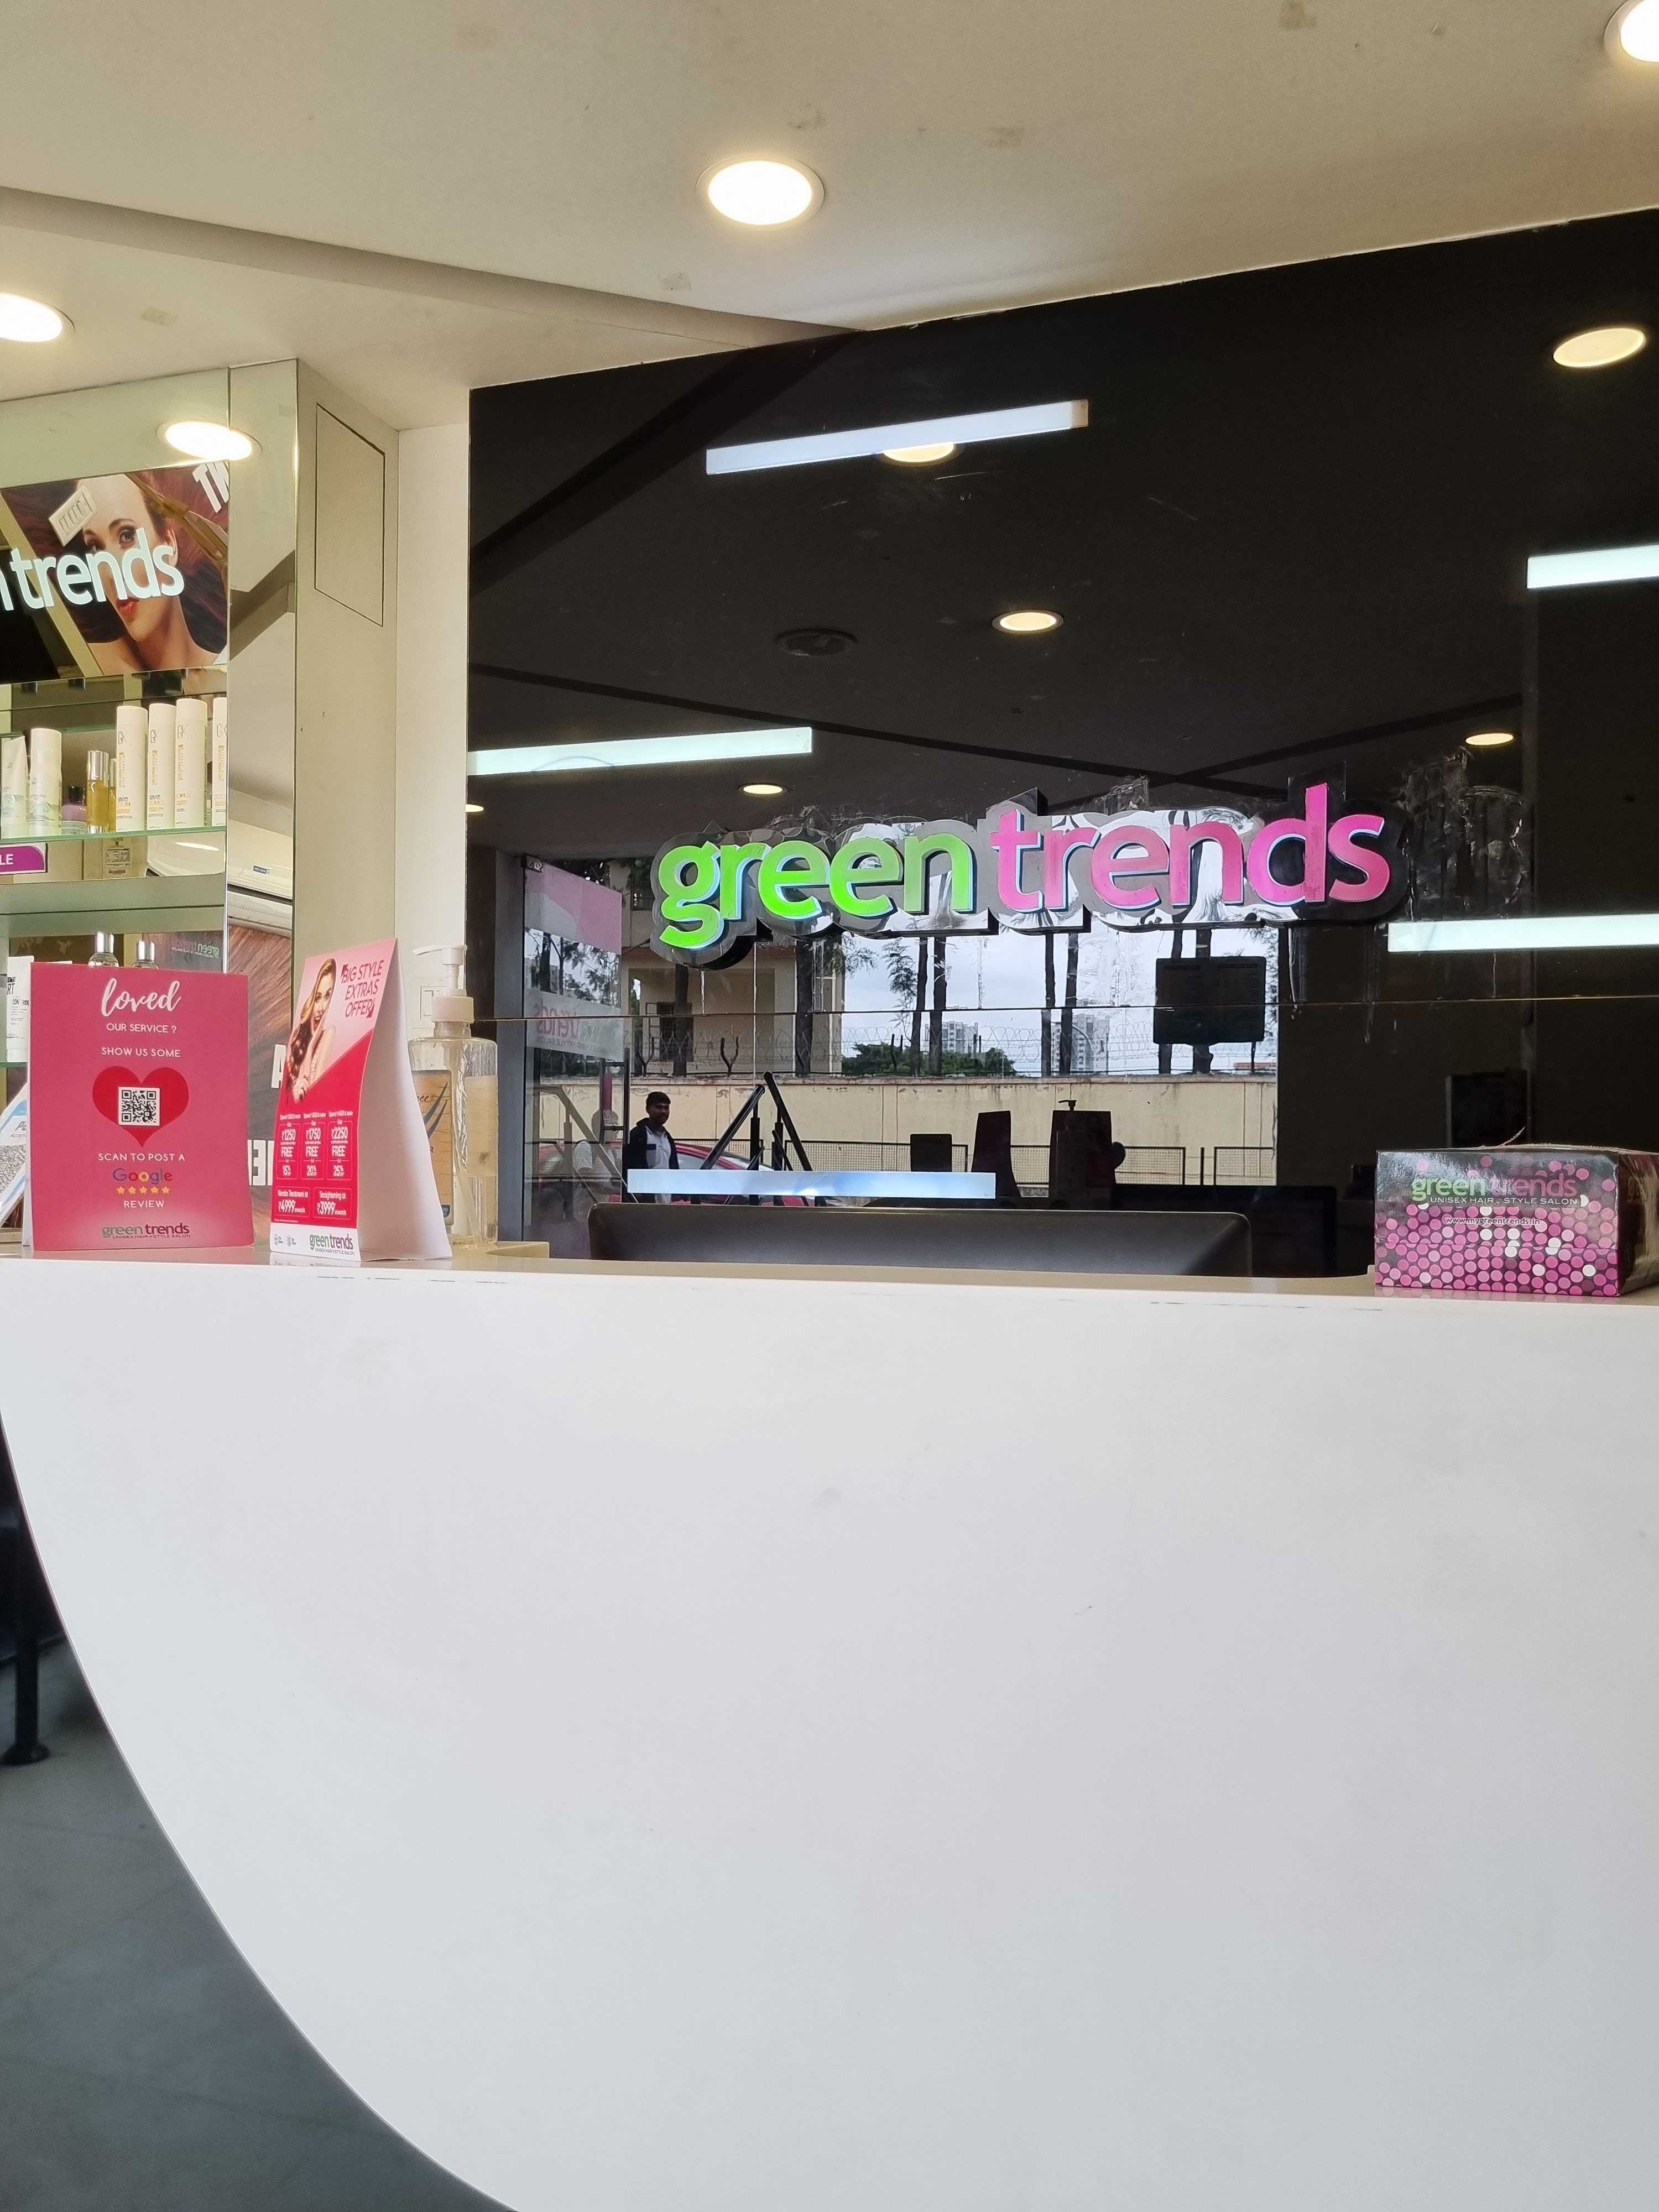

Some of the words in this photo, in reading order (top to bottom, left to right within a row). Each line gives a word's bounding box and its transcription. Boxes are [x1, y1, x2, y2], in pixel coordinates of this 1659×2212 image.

[10, 527, 184, 609] trends
[659, 833, 975, 949] green
[991, 783, 1391, 913] trends
[341, 964, 357, 984] BIG
[358, 960, 384, 980] STYLE
[101, 978, 182, 1016] loved
[345, 979, 379, 1000] EXTRAS
[129, 1024, 168, 1032] SERVICE
[151, 1049, 181, 1057] SOME
[113, 1168, 173, 1185] Google
[1411, 1177, 1485, 1201] green
[1491, 1173, 1577, 1197] trends
[102, 1226, 143, 1238] green
[145, 1223, 190, 1234] trends
[1446, 1217, 1540, 1225] www.mygreentrends.in
[310, 1234, 330, 1250] green
[330, 1233, 354, 1250] trends
